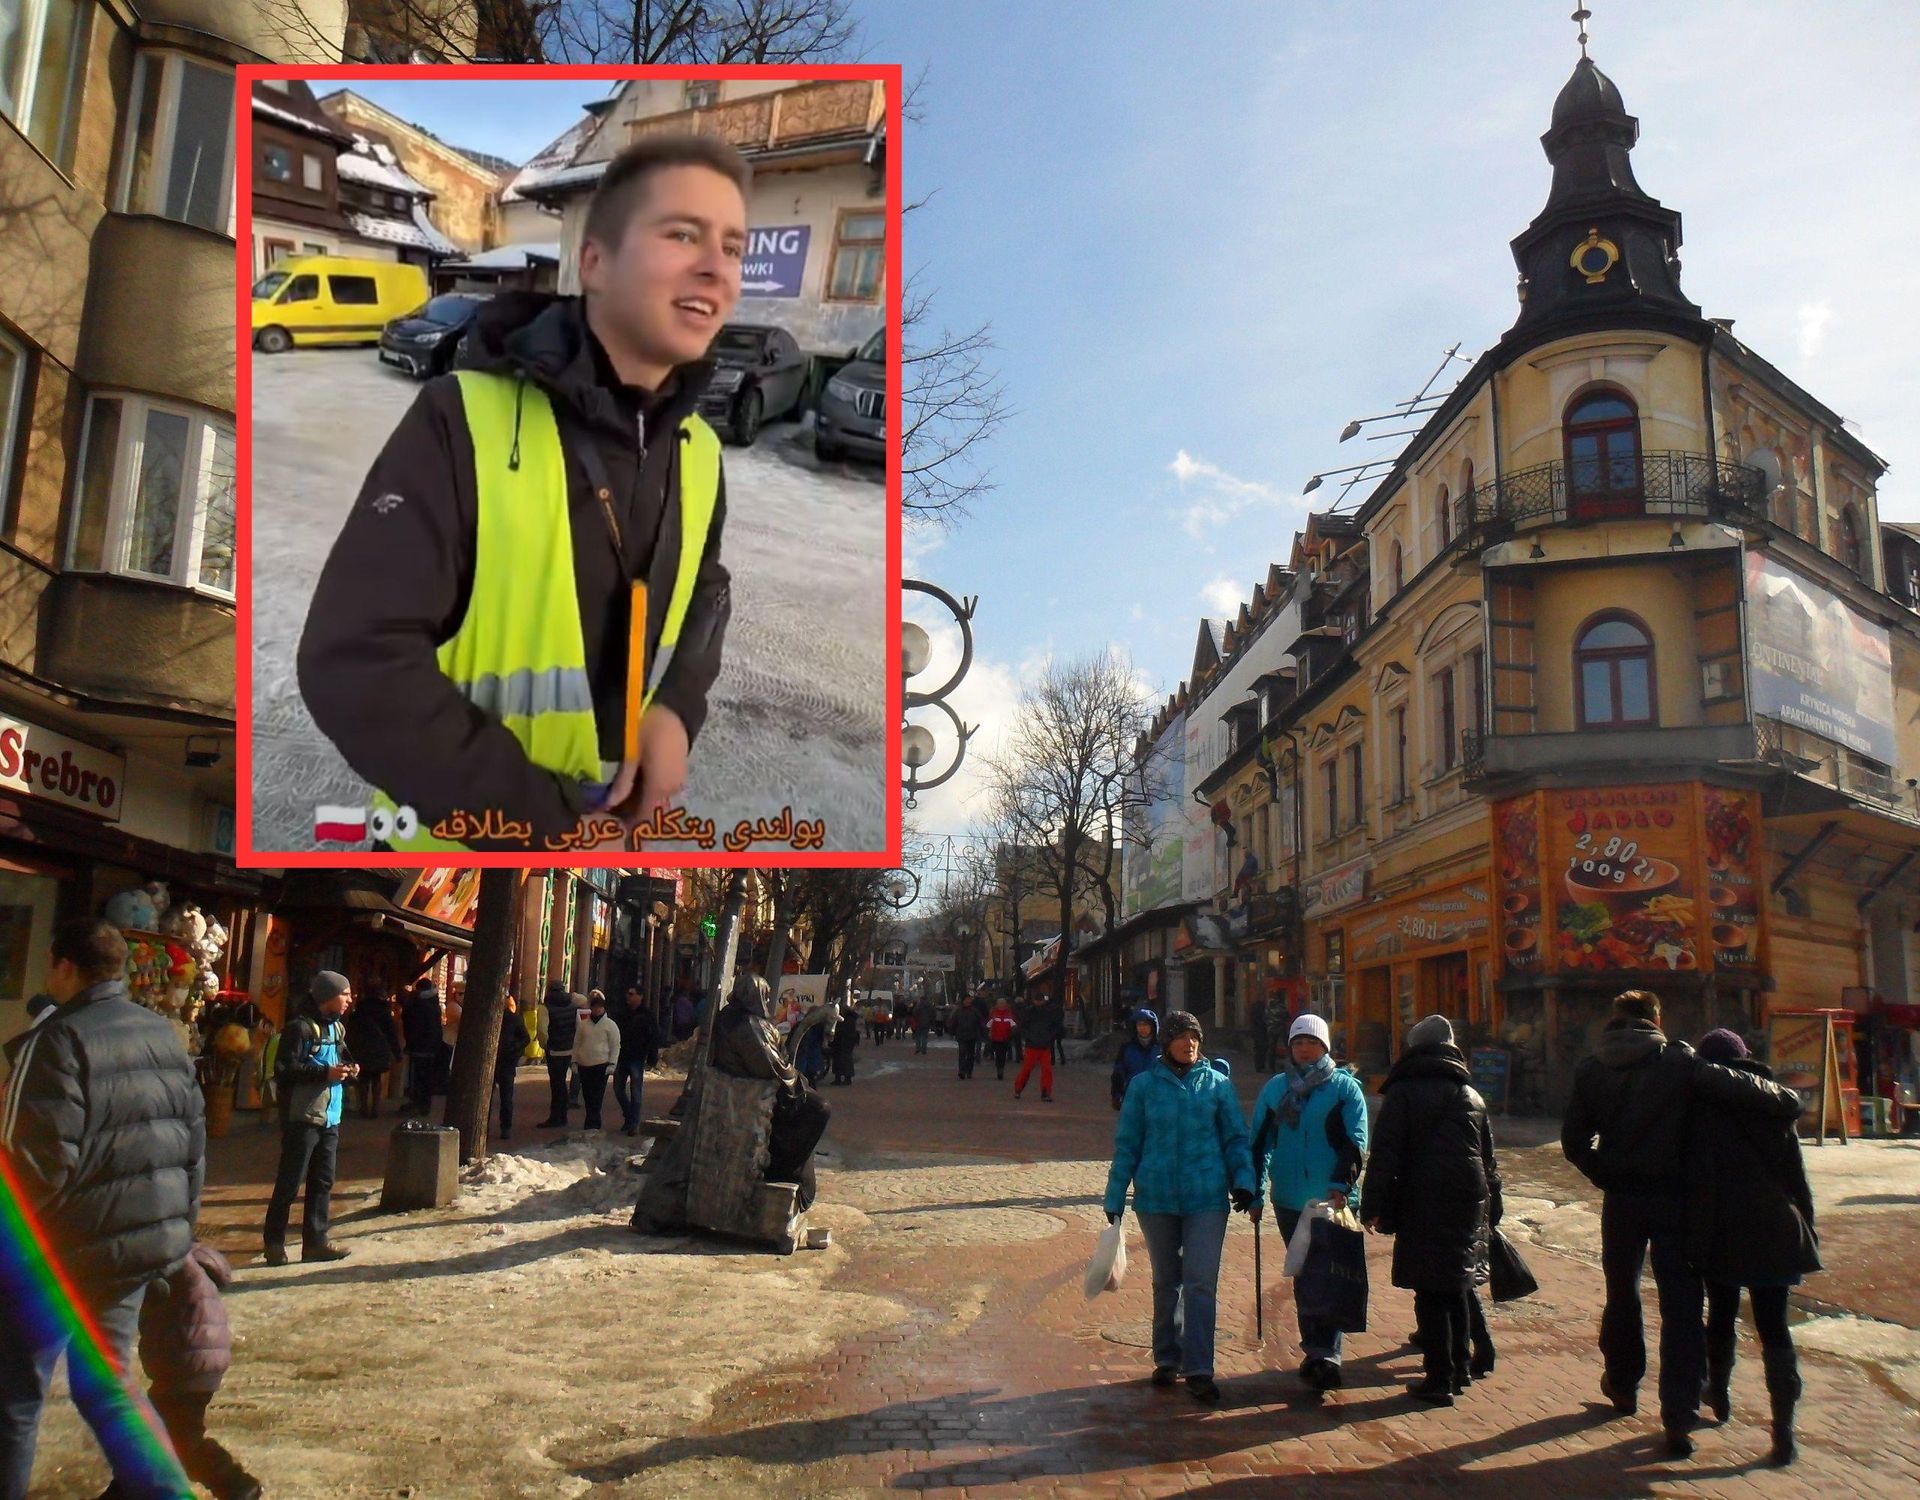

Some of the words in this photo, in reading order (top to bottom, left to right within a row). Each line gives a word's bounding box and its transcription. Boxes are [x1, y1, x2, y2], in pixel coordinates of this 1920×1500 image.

[747, 230, 800, 256] ING
[0, 728, 116, 808] Srebro
[562, 877, 578, 992] SPOR
